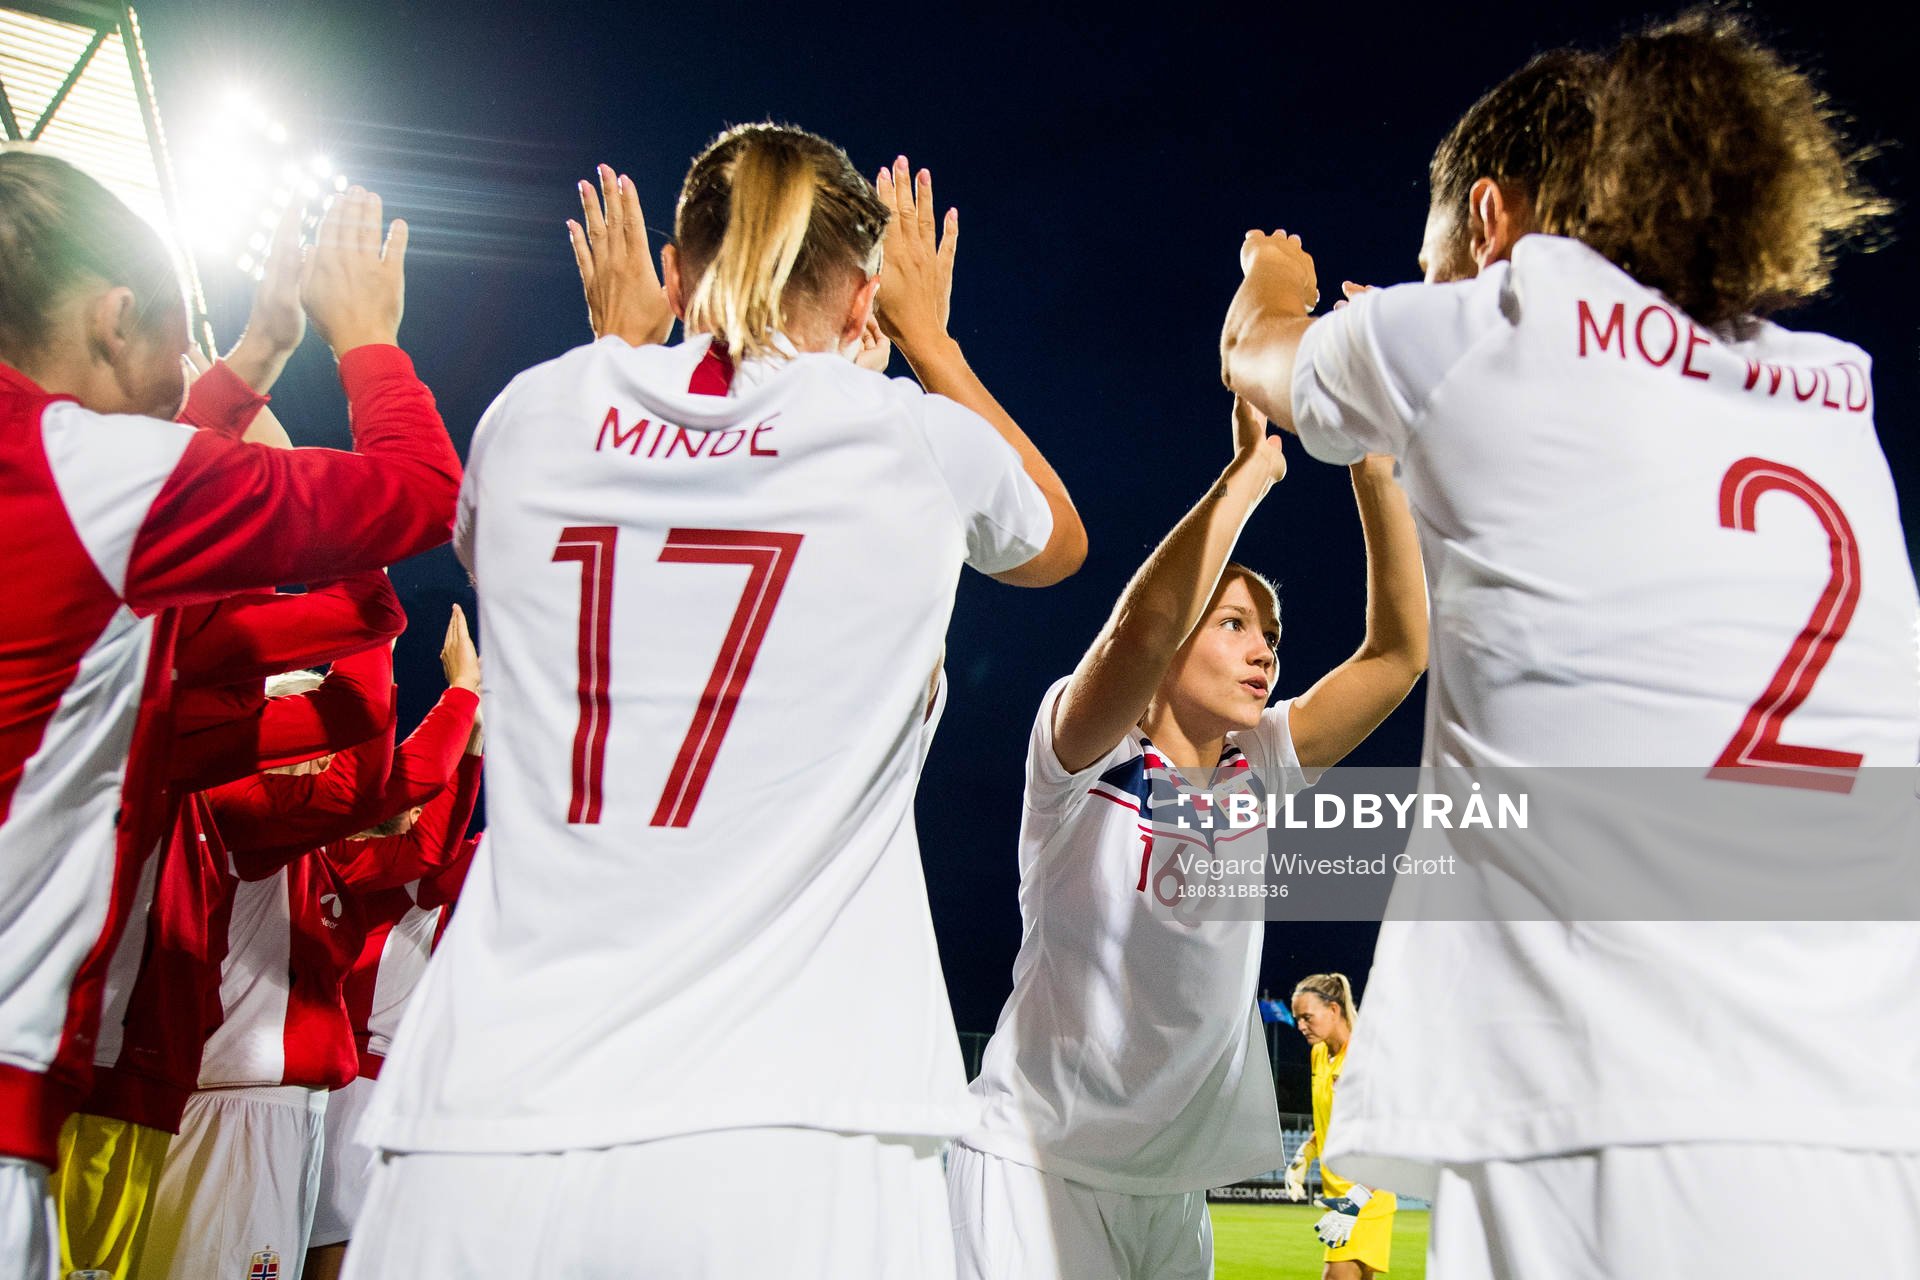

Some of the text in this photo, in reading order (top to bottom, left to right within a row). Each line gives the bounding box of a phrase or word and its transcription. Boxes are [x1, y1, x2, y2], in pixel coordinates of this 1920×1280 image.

[1577, 299, 1711, 381] MOE
[595, 405, 781, 458] MINDE
[1705, 456, 1865, 794] 2
[552, 526, 804, 828] 17
[1136, 833, 1189, 907] 16
